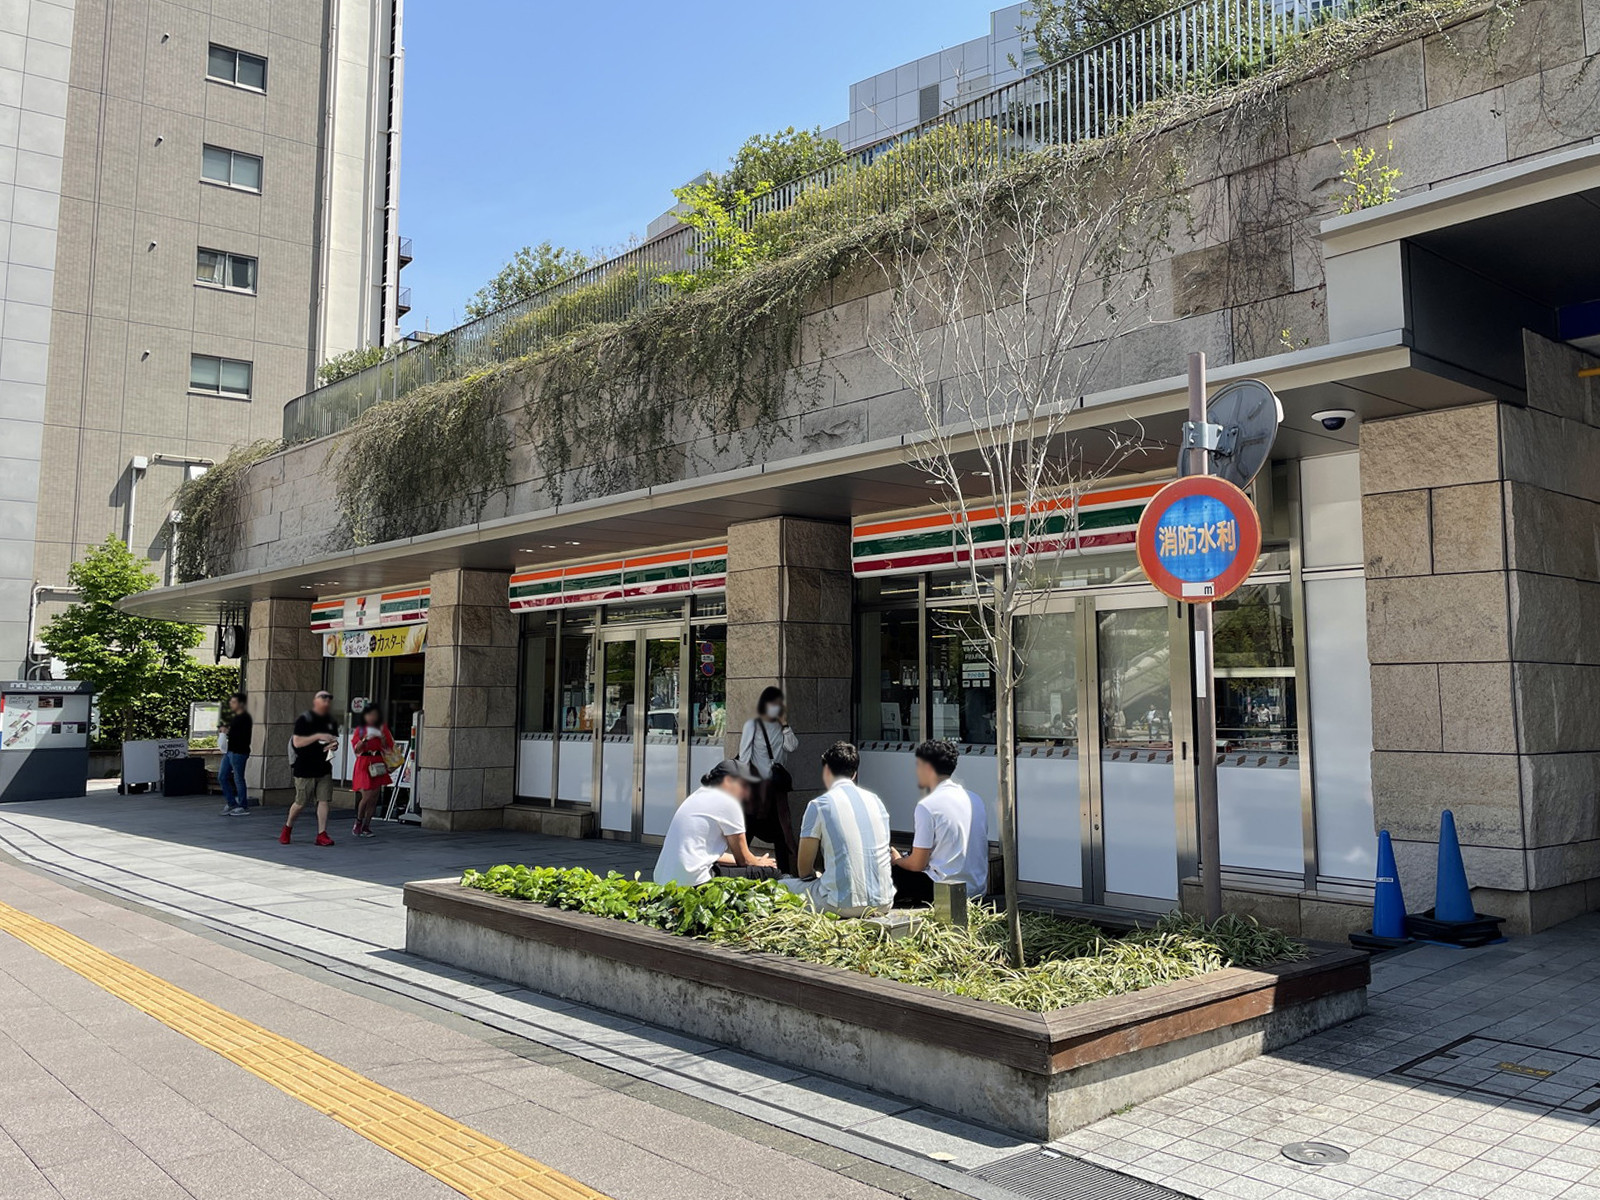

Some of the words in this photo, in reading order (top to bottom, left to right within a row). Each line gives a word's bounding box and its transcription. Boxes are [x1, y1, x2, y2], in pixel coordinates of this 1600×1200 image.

[1159, 519, 1237, 557] 消防水利
[1204, 585, 1213, 595] m
[377, 634, 406, 652] カスタード
